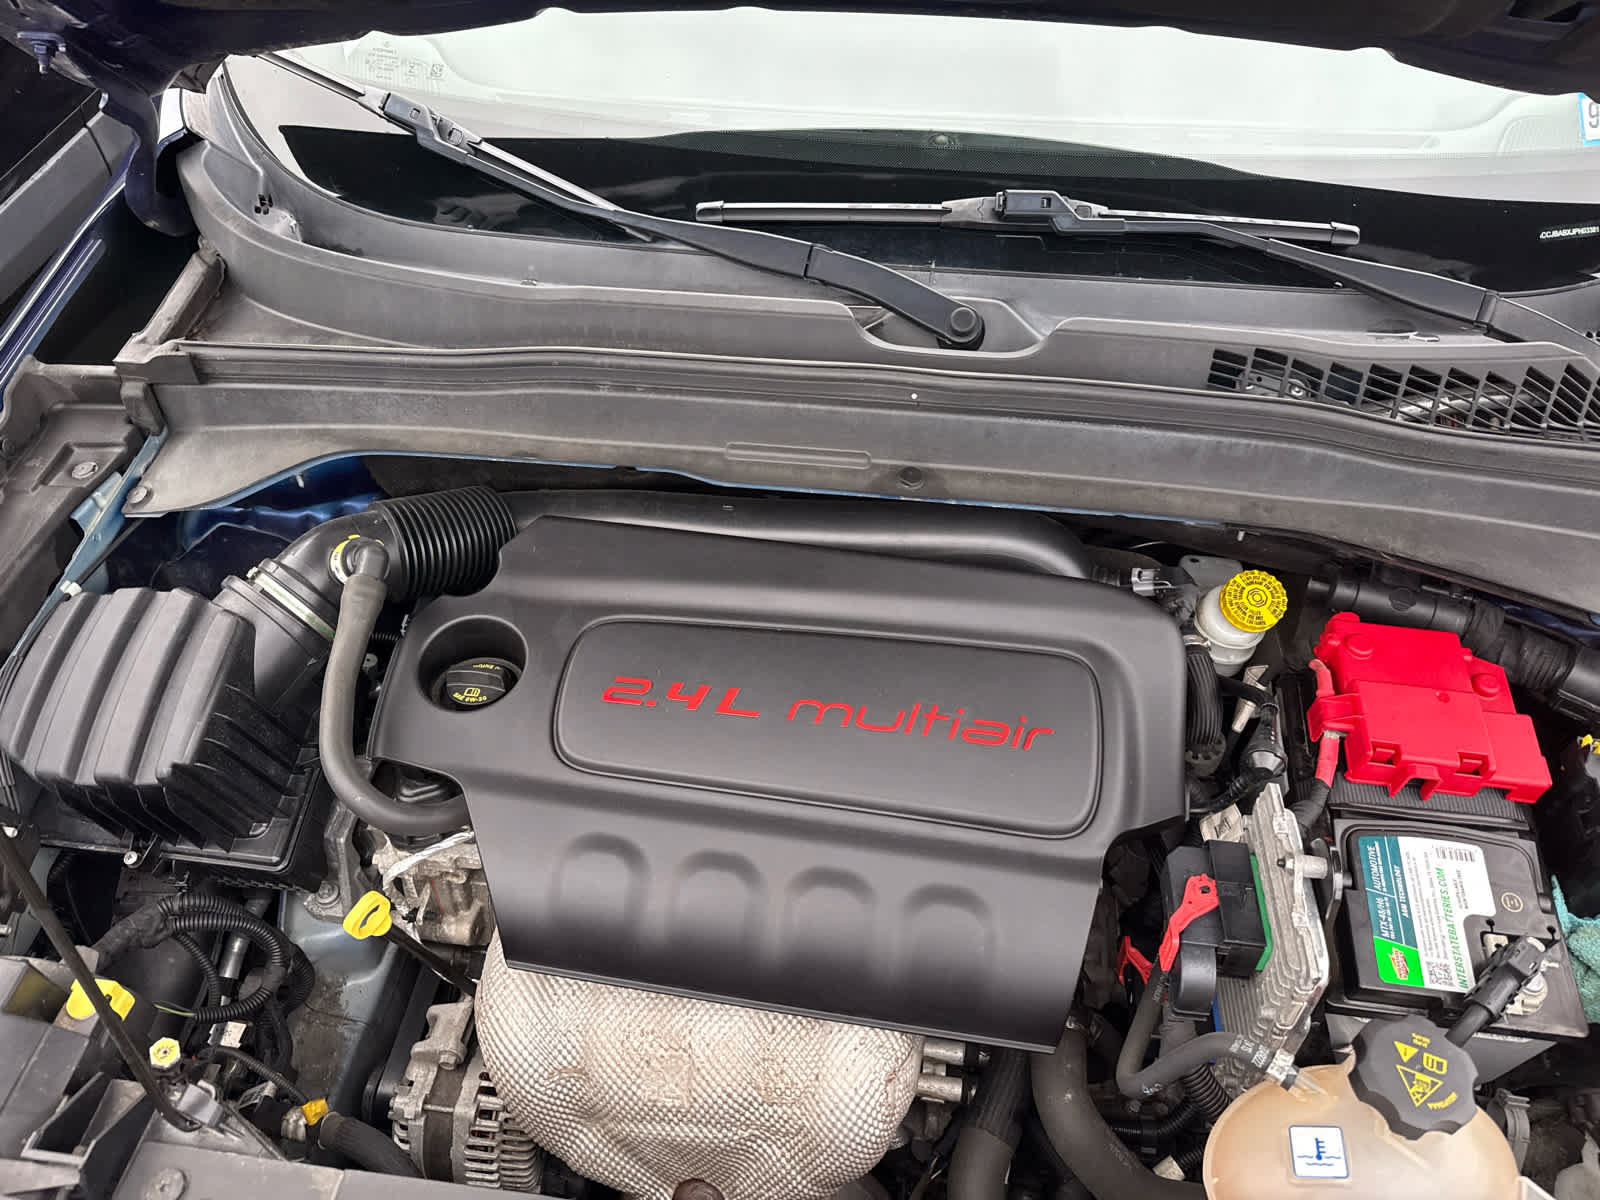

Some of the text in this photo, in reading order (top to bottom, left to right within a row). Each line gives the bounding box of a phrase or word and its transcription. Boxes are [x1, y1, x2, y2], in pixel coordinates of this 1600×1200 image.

[787, 701, 1055, 750] multiair
[1367, 845, 1382, 891] AUTOMOTIVE
[1435, 867, 1469, 989] INTERSTATEBATTERIES.COM
